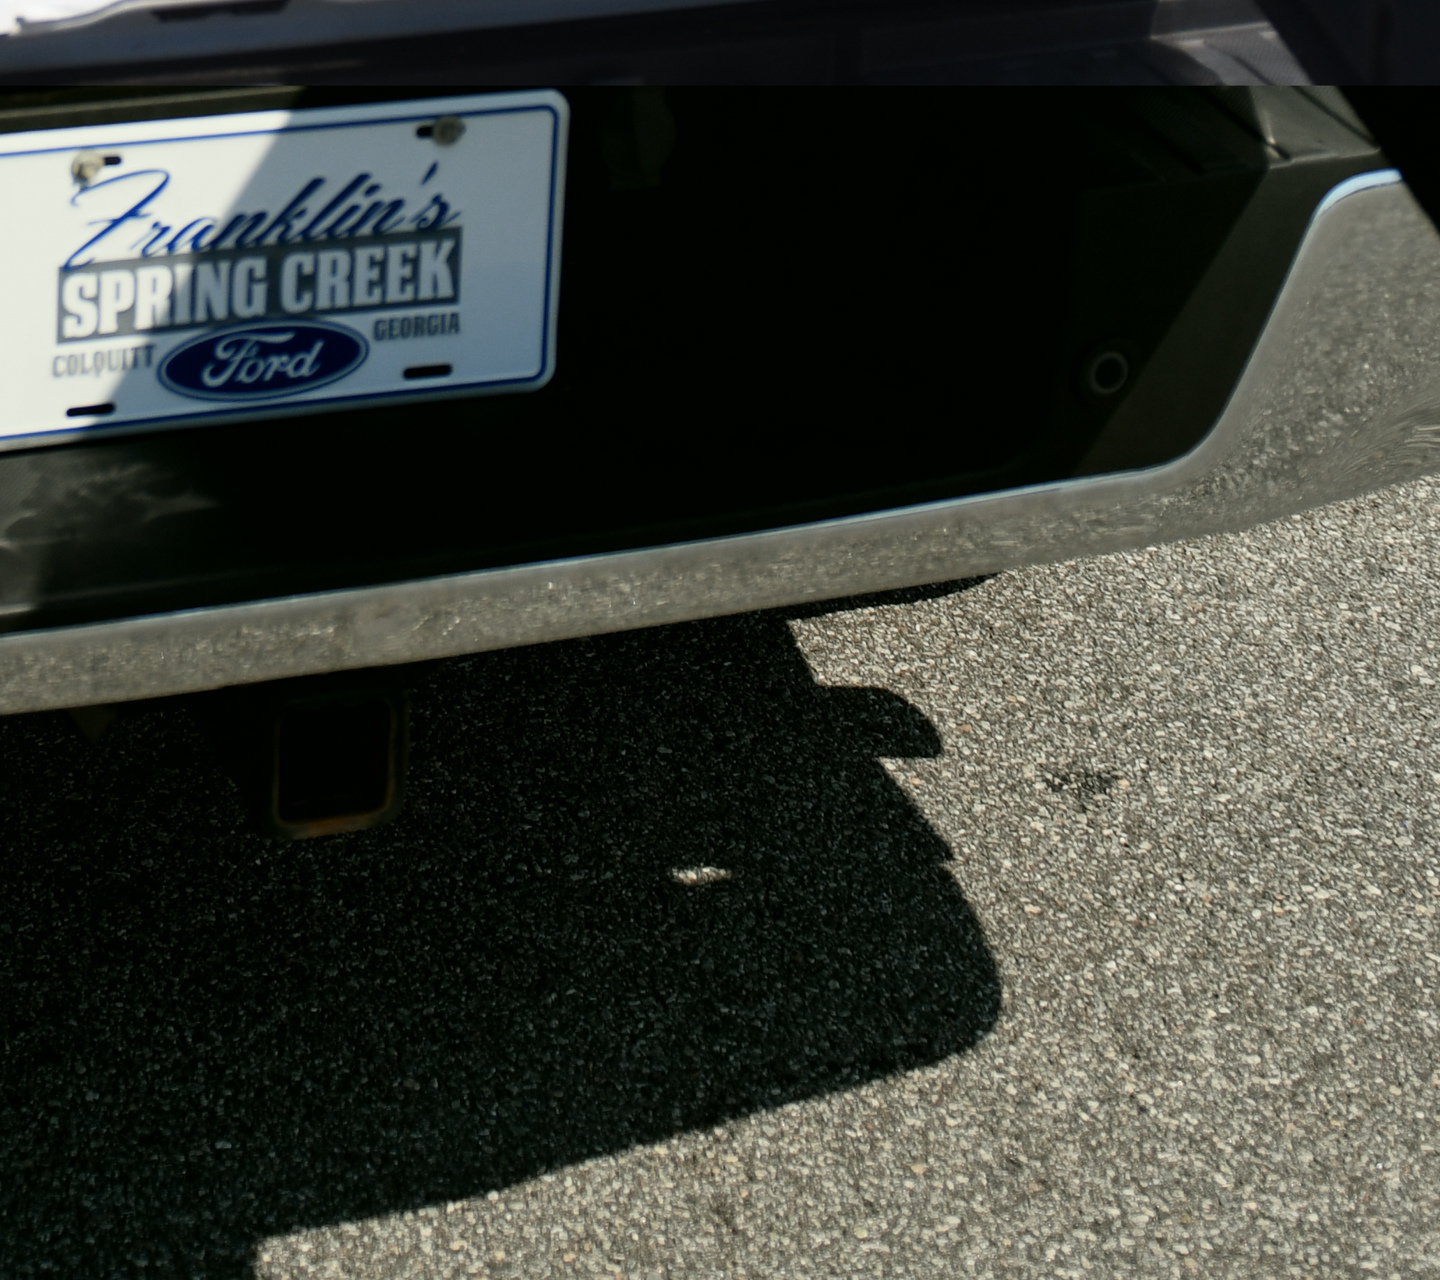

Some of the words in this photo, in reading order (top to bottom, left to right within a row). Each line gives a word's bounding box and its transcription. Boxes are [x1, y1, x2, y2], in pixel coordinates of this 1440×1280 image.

[63, 160, 463, 271] Franklin's
[61, 256, 268, 340] SPRING
[280, 238, 457, 315] CREEK
[373, 312, 461, 342] GEORGIA
[52, 343, 155, 379] COLQUITT
[201, 330, 321, 389] Ford
